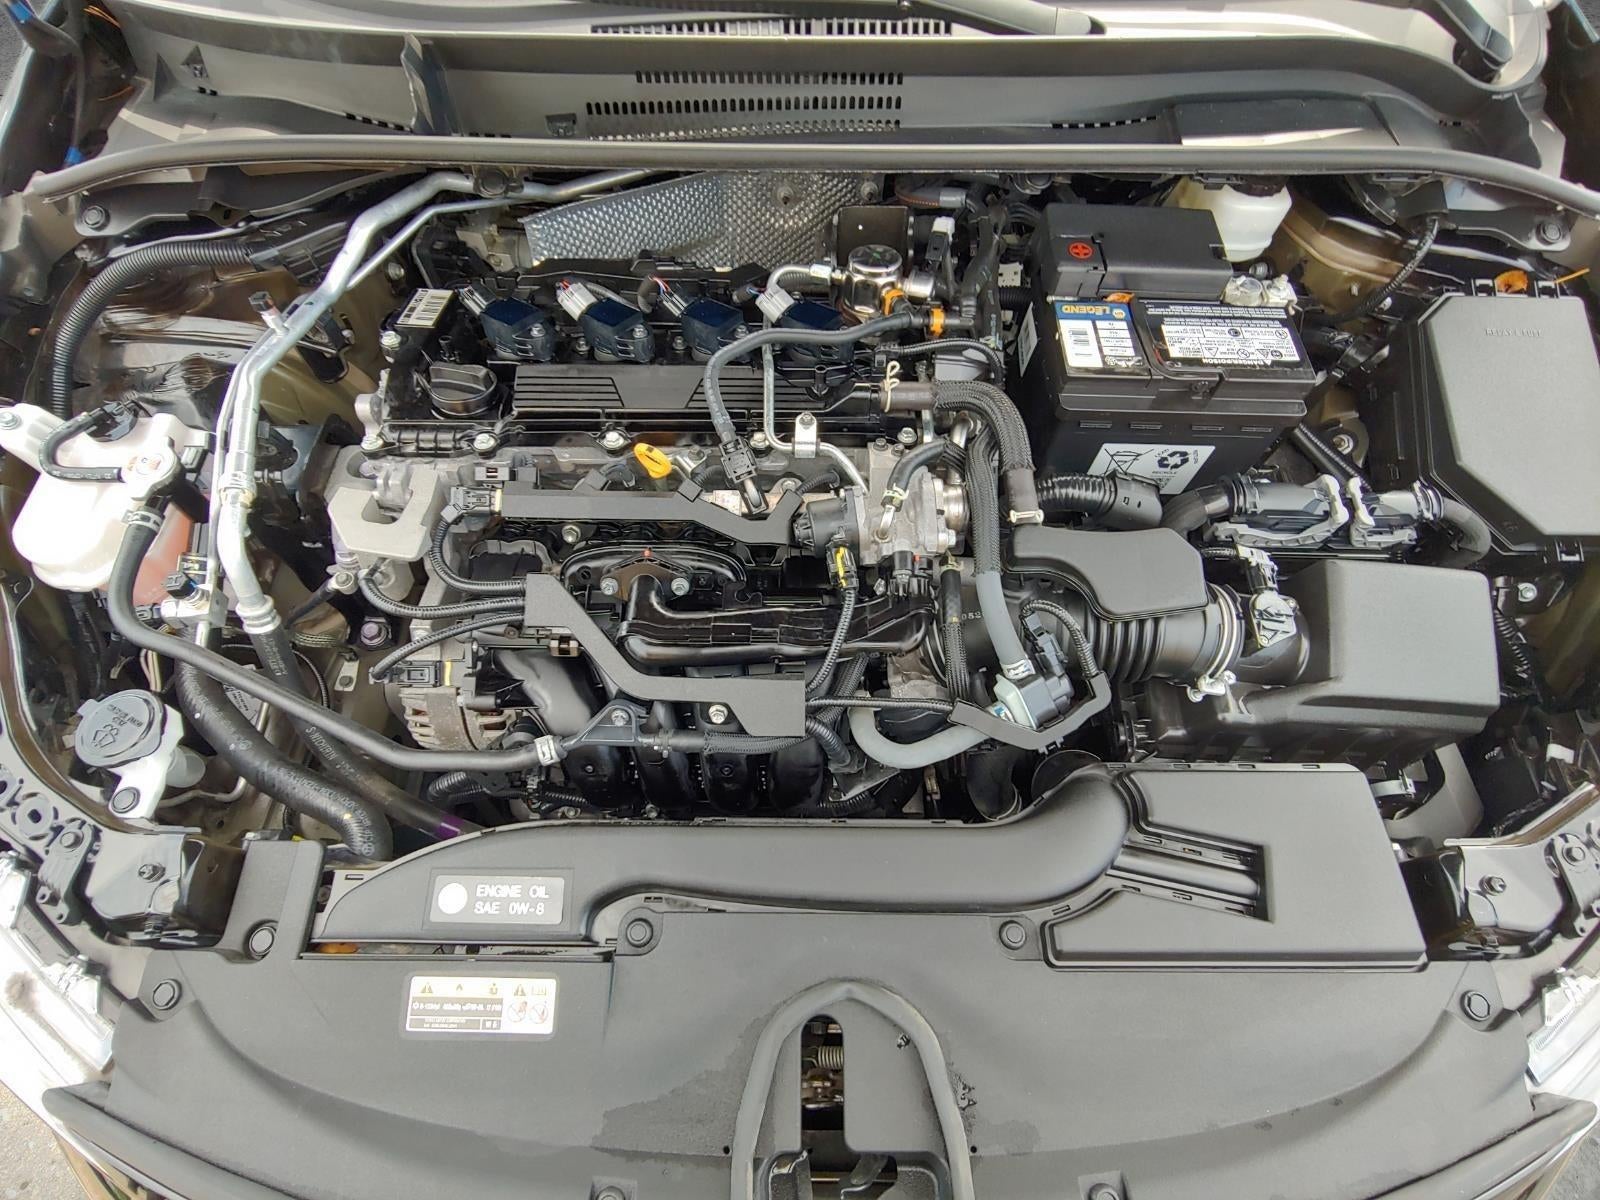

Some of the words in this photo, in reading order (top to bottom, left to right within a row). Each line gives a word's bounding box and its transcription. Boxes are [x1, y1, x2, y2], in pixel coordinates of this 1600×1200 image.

[1061, 304, 1111, 316] LEGEND
[476, 884, 522, 898] ENGINE
[528, 884, 550, 899] OIL
[474, 900, 501, 915] SAE
[508, 901, 545, 916] 0W-8
